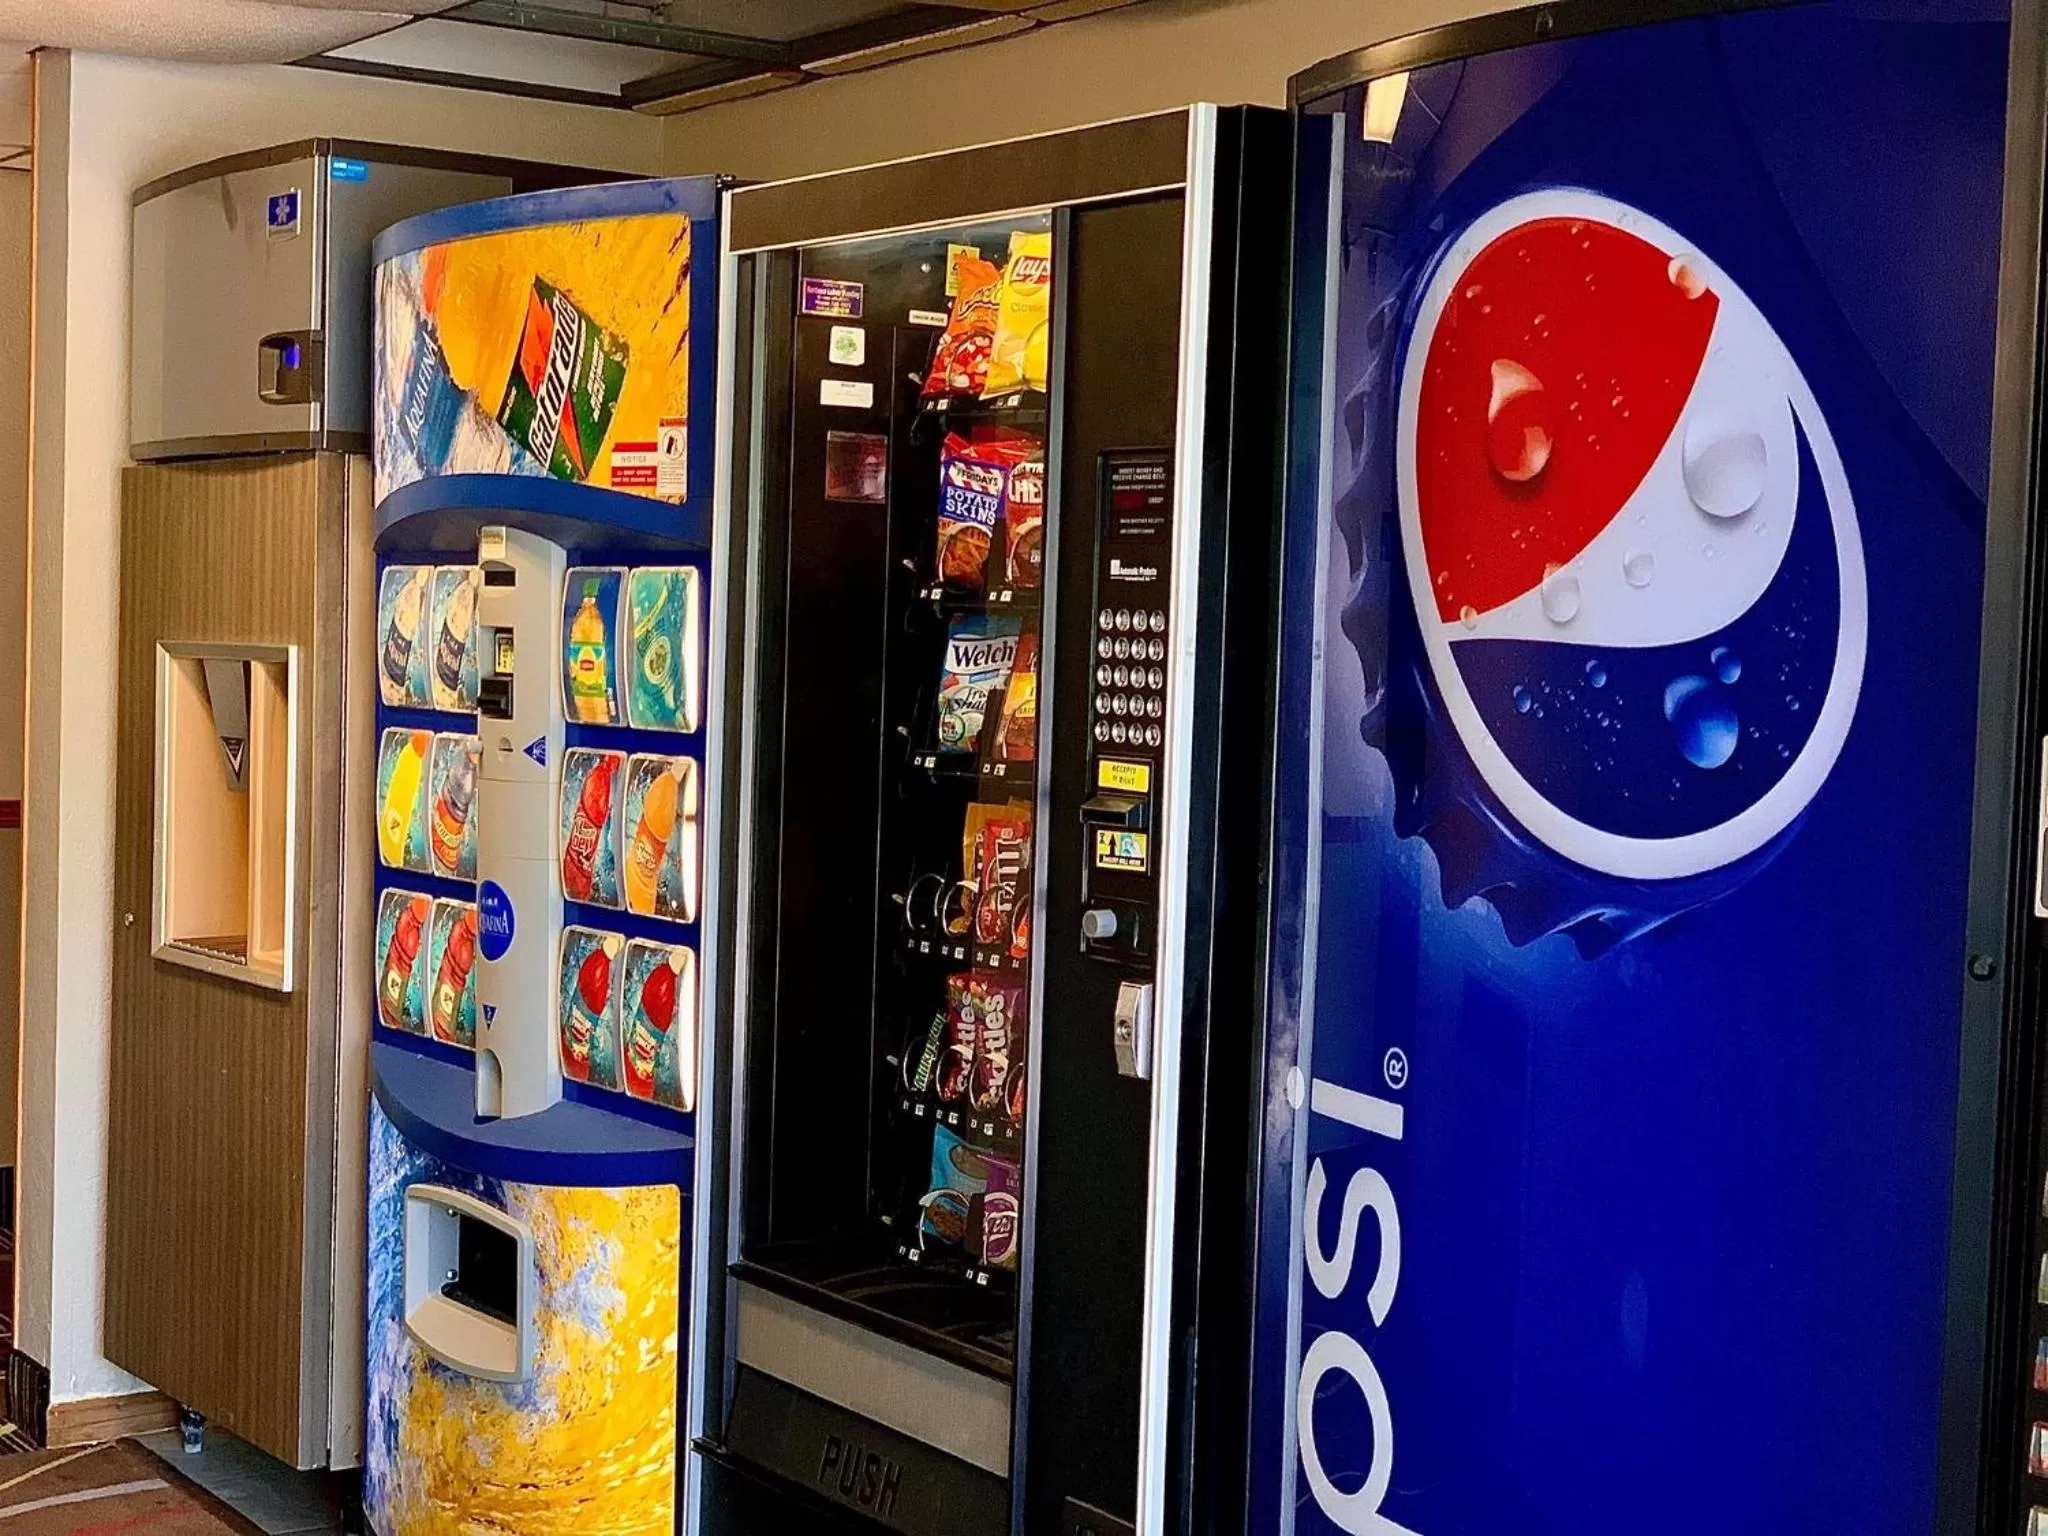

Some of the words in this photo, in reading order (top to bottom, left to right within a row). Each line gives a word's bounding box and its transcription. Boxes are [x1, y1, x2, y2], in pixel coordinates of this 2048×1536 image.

[404, 330, 439, 446] AQUAFINA
[529, 291, 579, 469] Gatorade
[945, 499, 996, 526] SKINS
[946, 485, 998, 511] POTATO
[955, 990, 976, 1094] sktles
[983, 993, 1009, 1102] sktles
[816, 1434, 903, 1517] PUSH
